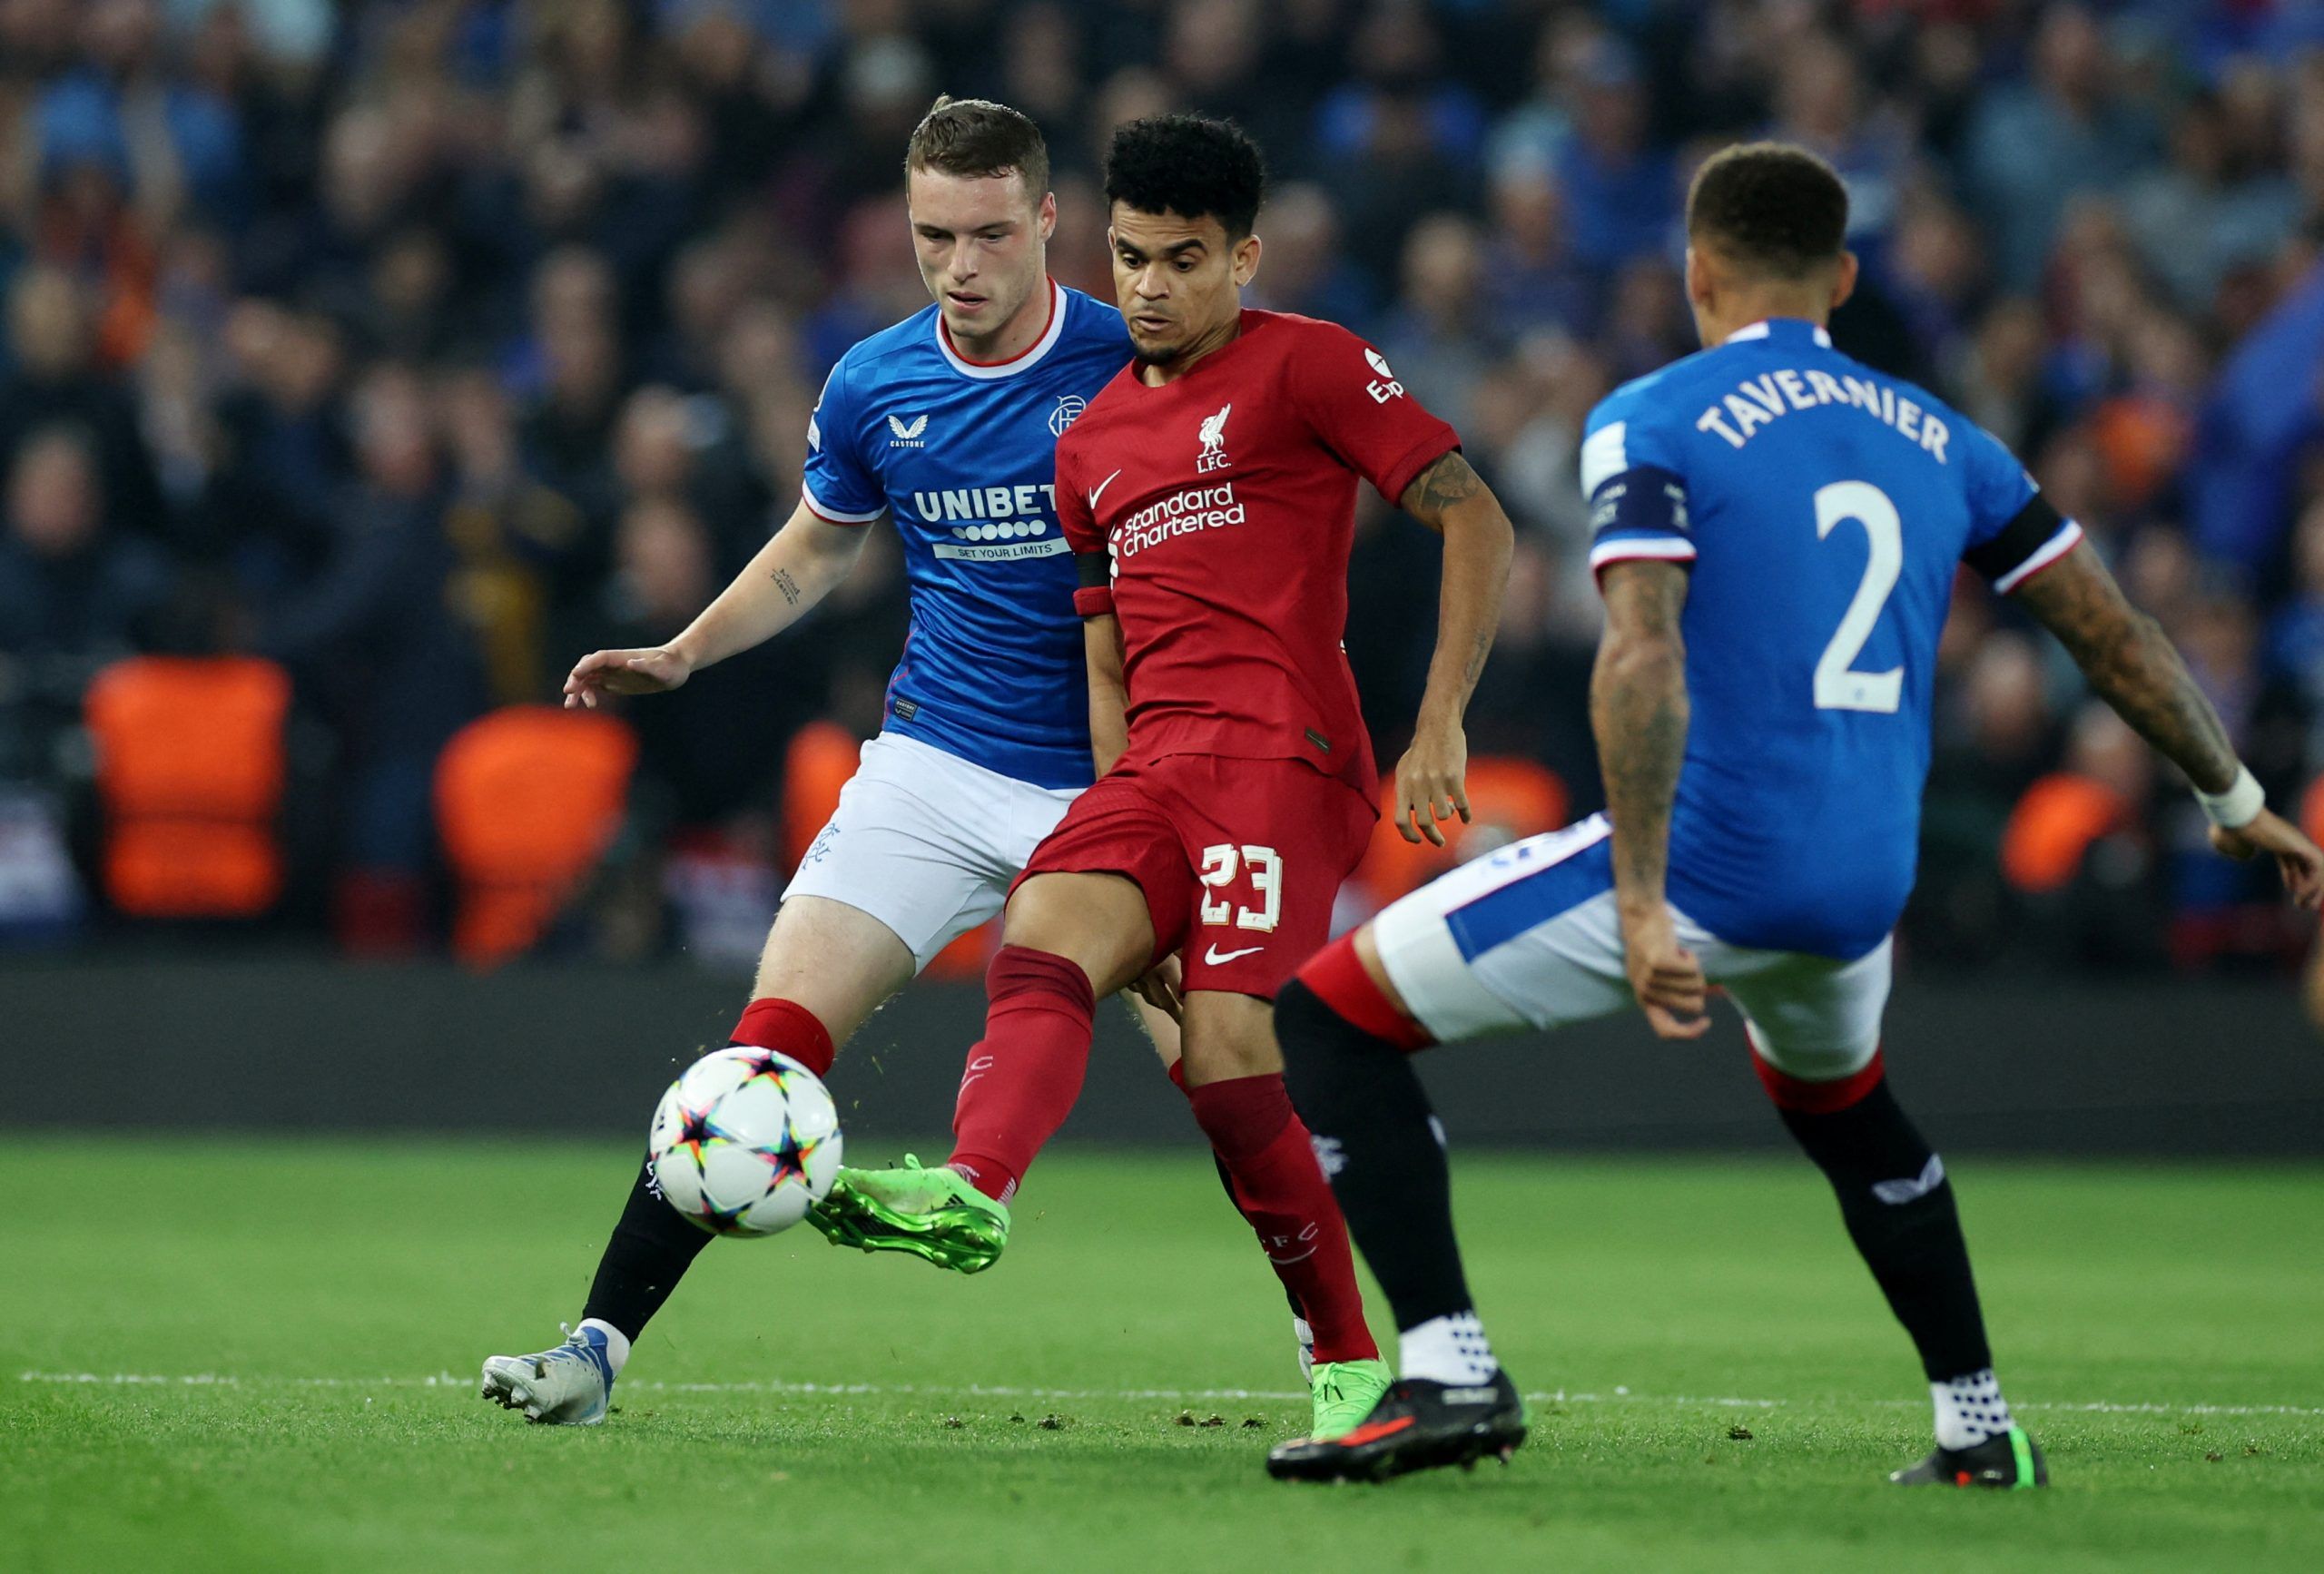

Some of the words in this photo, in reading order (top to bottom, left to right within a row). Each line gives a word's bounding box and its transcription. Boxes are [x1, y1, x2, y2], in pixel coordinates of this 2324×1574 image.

[1696, 369, 1949, 465] TAVERNIER
[1196, 453, 1232, 474] L.F.C.
[914, 484, 1057, 522] UNIBET
[1123, 503, 1246, 557] chartered
[1124, 482, 1235, 537] standard
[959, 548, 977, 557] SET
[979, 547, 1010, 558] YOUR
[1012, 544, 1053, 556] LIMITS
[1814, 480, 1903, 713] 2
[1199, 843, 1283, 933] 23
